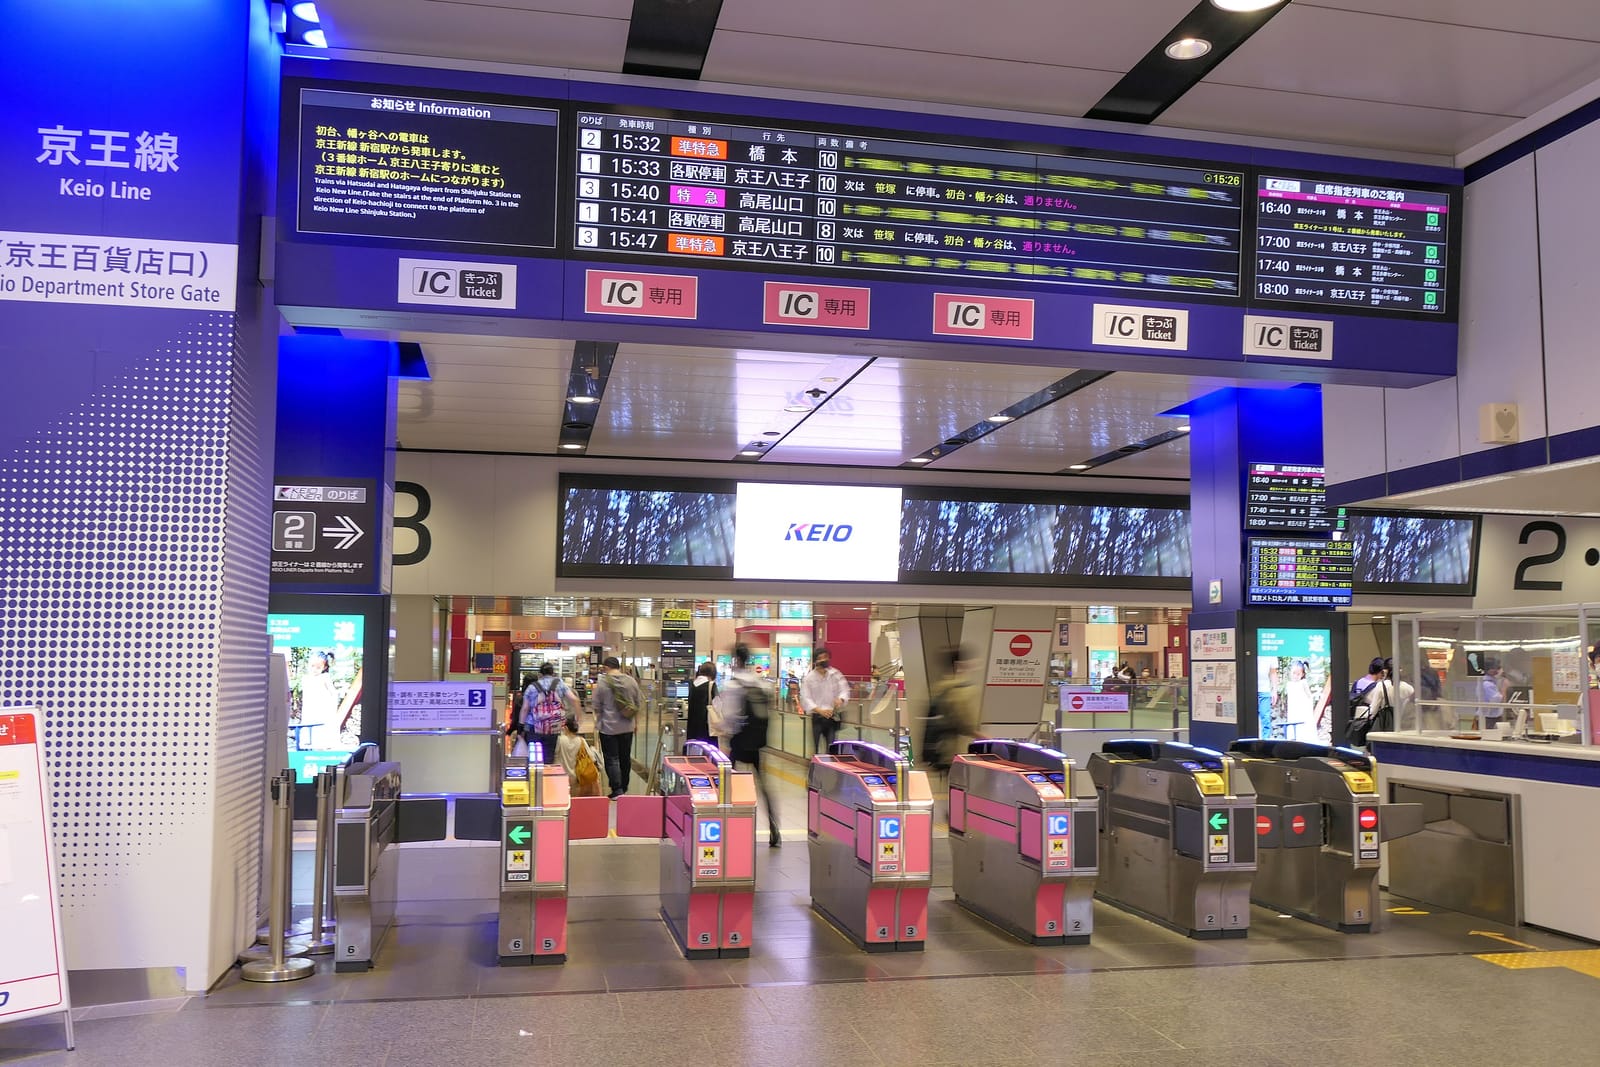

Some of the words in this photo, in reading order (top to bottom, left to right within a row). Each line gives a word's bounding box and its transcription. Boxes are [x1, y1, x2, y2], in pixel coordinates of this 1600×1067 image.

[371, 97, 415, 112] お知らせ
[418, 98, 491, 119] Information
[580, 115, 603, 126] のりば
[618, 119, 654, 131] 発車時刻
[35, 124, 180, 173] 京王線
[315, 138, 357, 152] 京王新線
[359, 141, 466, 160] 新宿駅から発車します。
[586, 132, 596, 146] 2
[611, 134, 661, 153] 15:32
[678, 139, 721, 156] 準特急
[820, 152, 836, 168] 10
[315, 164, 356, 178] 京王新線
[586, 157, 594, 170] 1
[611, 158, 660, 177] 15:33
[672, 163, 725, 182] 各駅停車
[734, 167, 811, 190] 京王八王子
[820, 177, 835, 192] 10
[844, 180, 865, 191] 次は
[875, 183, 896, 194] 笹塚
[314, 177, 335, 185] Trains
[346, 180, 376, 188] Hatsudai
[390, 183, 421, 192] Hatagaya
[422, 185, 443, 193] depart
[460, 188, 488, 197] Shinjuku
[489, 190, 511, 198] Station
[1213, 174, 1240, 186] 15:26
[59, 178, 104, 197] Keio
[110, 181, 152, 200] Line
[313, 196, 343, 204] direction
[352, 198, 393, 208] Keio-hachioji
[449, 205, 477, 214] platform
[454, 197, 481, 205] Platform
[585, 181, 594, 194] 3
[610, 183, 660, 201] 15:40
[739, 192, 803, 213] 高尾山口
[819, 201, 834, 216] 10
[360, 208, 388, 217] Shinjuku
[1259, 201, 1291, 215] 16:40
[585, 206, 592, 219] 1
[609, 206, 657, 225] 15:41
[671, 211, 724, 229] 各駅停車
[738, 216, 803, 236] 高尾山口
[821, 225, 831, 238] 8
[843, 227, 864, 238] 次は
[873, 229, 895, 242] 笹塚
[583, 231, 593, 244] 3
[609, 231, 658, 249] 15:47
[675, 236, 717, 253] 準特急
[732, 240, 809, 262] 京王八王子
[818, 246, 833, 262] 10
[1259, 235, 1291, 248] 17:00
[1331, 242, 1367, 255] 京王八王子
[1258, 259, 1290, 272] 17:40
[418, 271, 451, 294] IC
[463, 271, 497, 286] きっぷ
[22, 276, 124, 298] Department
[130, 281, 175, 300] Store
[181, 284, 220, 303] Gate
[464, 285, 497, 299] Ticket
[606, 282, 638, 305] IC
[648, 287, 683, 306] 専用
[1257, 282, 1289, 296] 18:00
[1330, 288, 1366, 301] 京王八王子
[784, 293, 814, 316] IC
[824, 299, 856, 317] 専用
[952, 304, 981, 327] IC
[989, 310, 1021, 328] 専用
[1146, 316, 1174, 330] きっぷ
[1109, 314, 1136, 336] IC
[1146, 329, 1173, 342] Ticket
[1258, 326, 1284, 347] IC
[1293, 328, 1320, 341] きっぷ
[1293, 339, 1319, 352] Ticket
[327, 490, 359, 500] のりば
[284, 515, 305, 539] 2
[784, 523, 853, 542] KEIO
[1127, 630, 1134, 639] A
[472, 690, 482, 706] 3
[699, 822, 720, 841] IC
[879, 819, 899, 838] IC
[1048, 816, 1068, 835] IC
[1207, 915, 1214, 923] 2
[1233, 915, 1238, 923] 1
[1357, 910, 1362, 918] 1
[879, 927, 887, 936] 4
[907, 927, 914, 935] 3
[1048, 921, 1055, 930] 3
[1073, 920, 1081, 929] 2
[513, 940, 521, 949] 6
[544, 939, 551, 948] 5
[701, 934, 709, 942] 5
[730, 933, 738, 942] 4
[347, 946, 355, 954] 6
